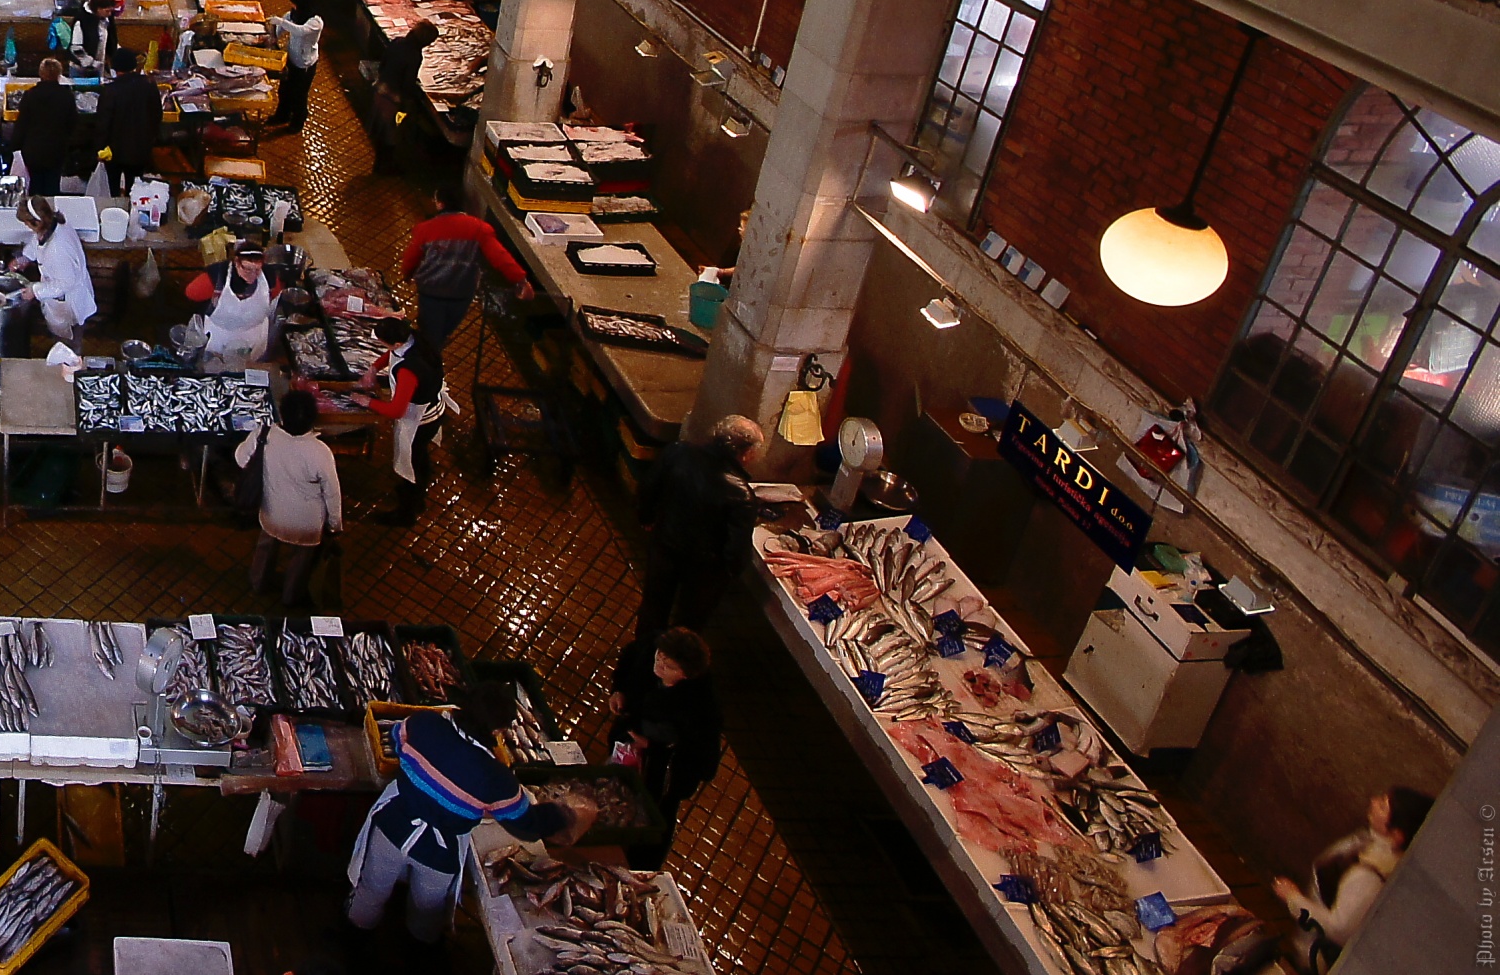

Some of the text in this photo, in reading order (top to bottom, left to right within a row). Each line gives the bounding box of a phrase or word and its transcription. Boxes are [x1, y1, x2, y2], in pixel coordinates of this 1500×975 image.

[1018, 413, 1110, 506] TARDI
[1110, 507, 1135, 534] d.o.o.
[1052, 474, 1093, 513] turistička
